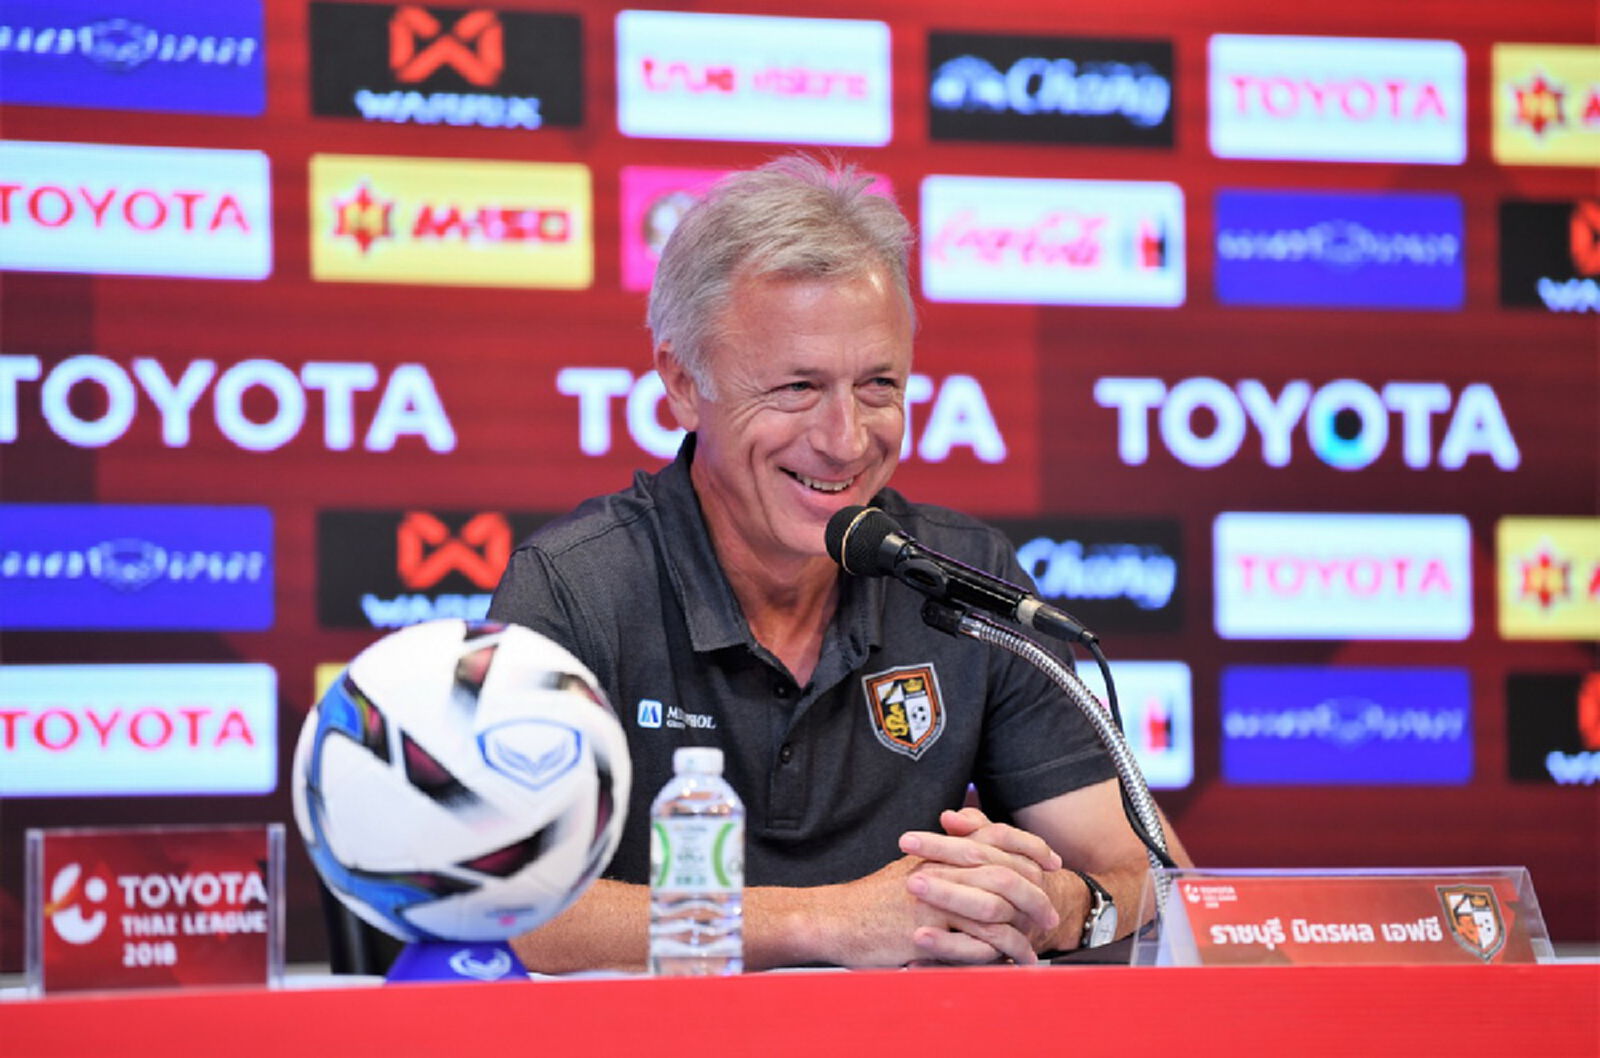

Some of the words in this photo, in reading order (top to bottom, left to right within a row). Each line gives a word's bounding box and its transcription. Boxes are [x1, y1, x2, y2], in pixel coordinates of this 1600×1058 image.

[1229, 75, 1448, 122] TOYOTA
[0, 182, 251, 235] TOYOTA
[0, 354, 457, 454] TOYOTA
[1093, 376, 1523, 471] TOYOTA
[1236, 555, 1454, 596] TOYOTA
[0, 706, 256, 753] TOYOTA
[117, 871, 269, 909] TOYOTA
